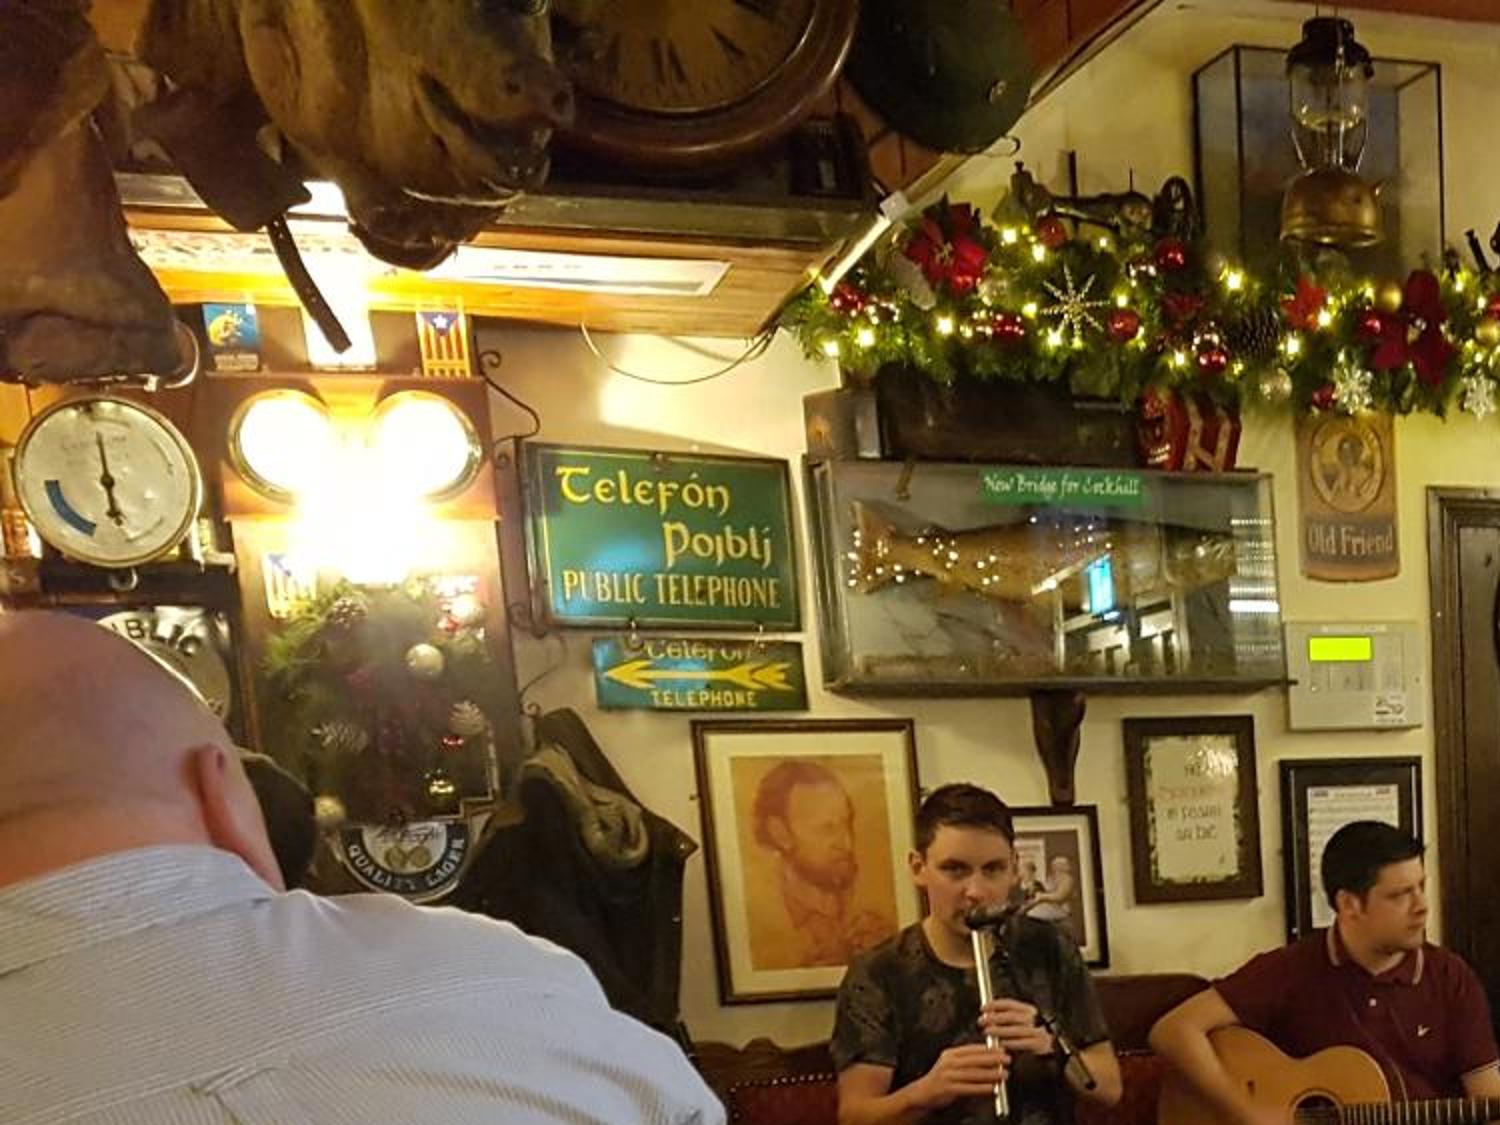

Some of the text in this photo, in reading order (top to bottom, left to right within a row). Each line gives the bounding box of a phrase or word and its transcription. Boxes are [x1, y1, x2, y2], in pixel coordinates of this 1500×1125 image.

[983, 473, 1014, 493] New
[1016, 472, 1057, 502] Bridge
[1060, 473, 1079, 501] for
[1308, 522, 1393, 556] Old Friend
[562, 569, 782, 608] PUBLIC TELEPHONE
[650, 689, 758, 708] TELEPHONE
[348, 844, 416, 890] QUALITY
